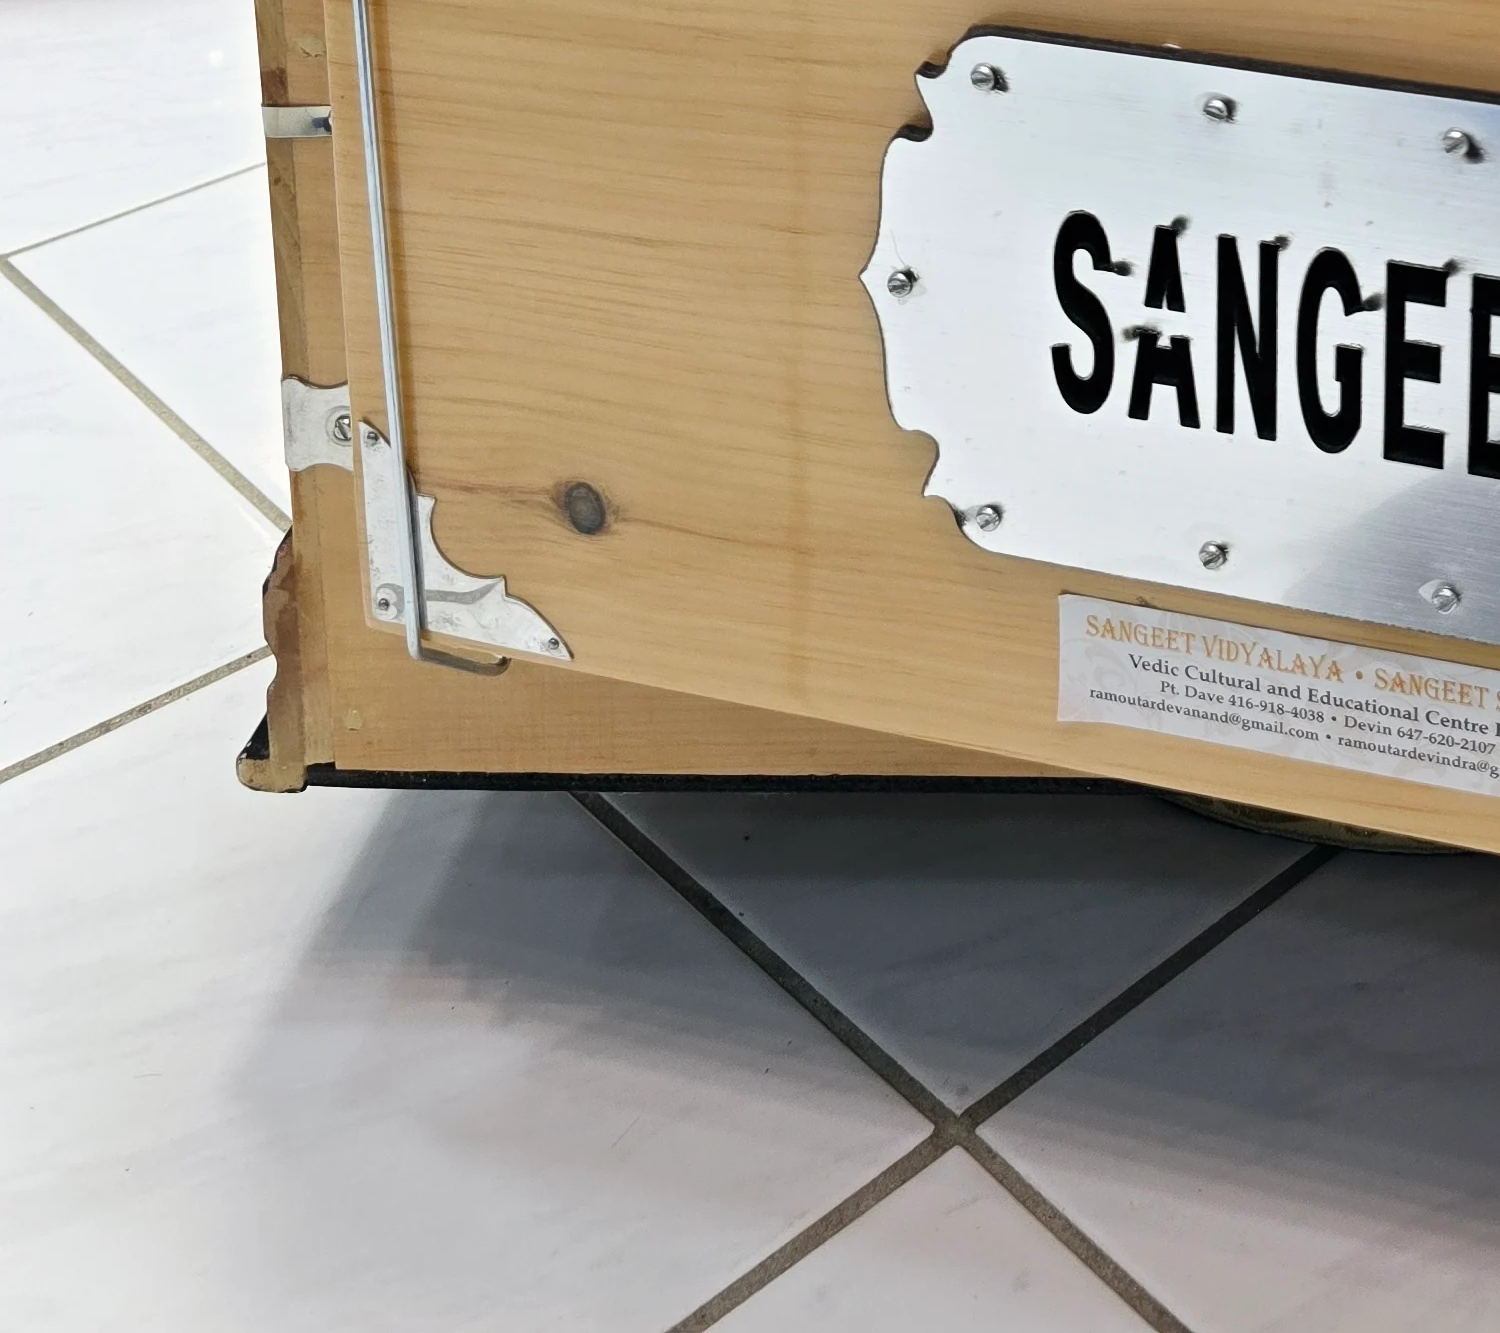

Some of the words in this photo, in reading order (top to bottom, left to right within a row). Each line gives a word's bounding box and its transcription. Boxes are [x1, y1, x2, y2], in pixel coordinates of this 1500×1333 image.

[1085, 614, 1196, 655] SANGEET
[1200, 634, 1345, 683] VIDYALAYA
[1373, 667, 1490, 710] SANGEET
[1128, 652, 1180, 677] Vedic
[1184, 663, 1261, 692] Cultural
[1266, 681, 1302, 700] and
[1307, 687, 1420, 722] Educational
[1424, 709, 1490, 735] Centre
[1089, 687, 1320, 742] ramoutardevanand@gmail.com
[1159, 680, 1180, 696] Pt.
[1184, 684, 1225, 704] Dave
[1227, 693, 1326, 724] 416-918-4038
[1343, 715, 1393, 736] Devin
[1396, 726, 1497, 756] 647-620-2107
